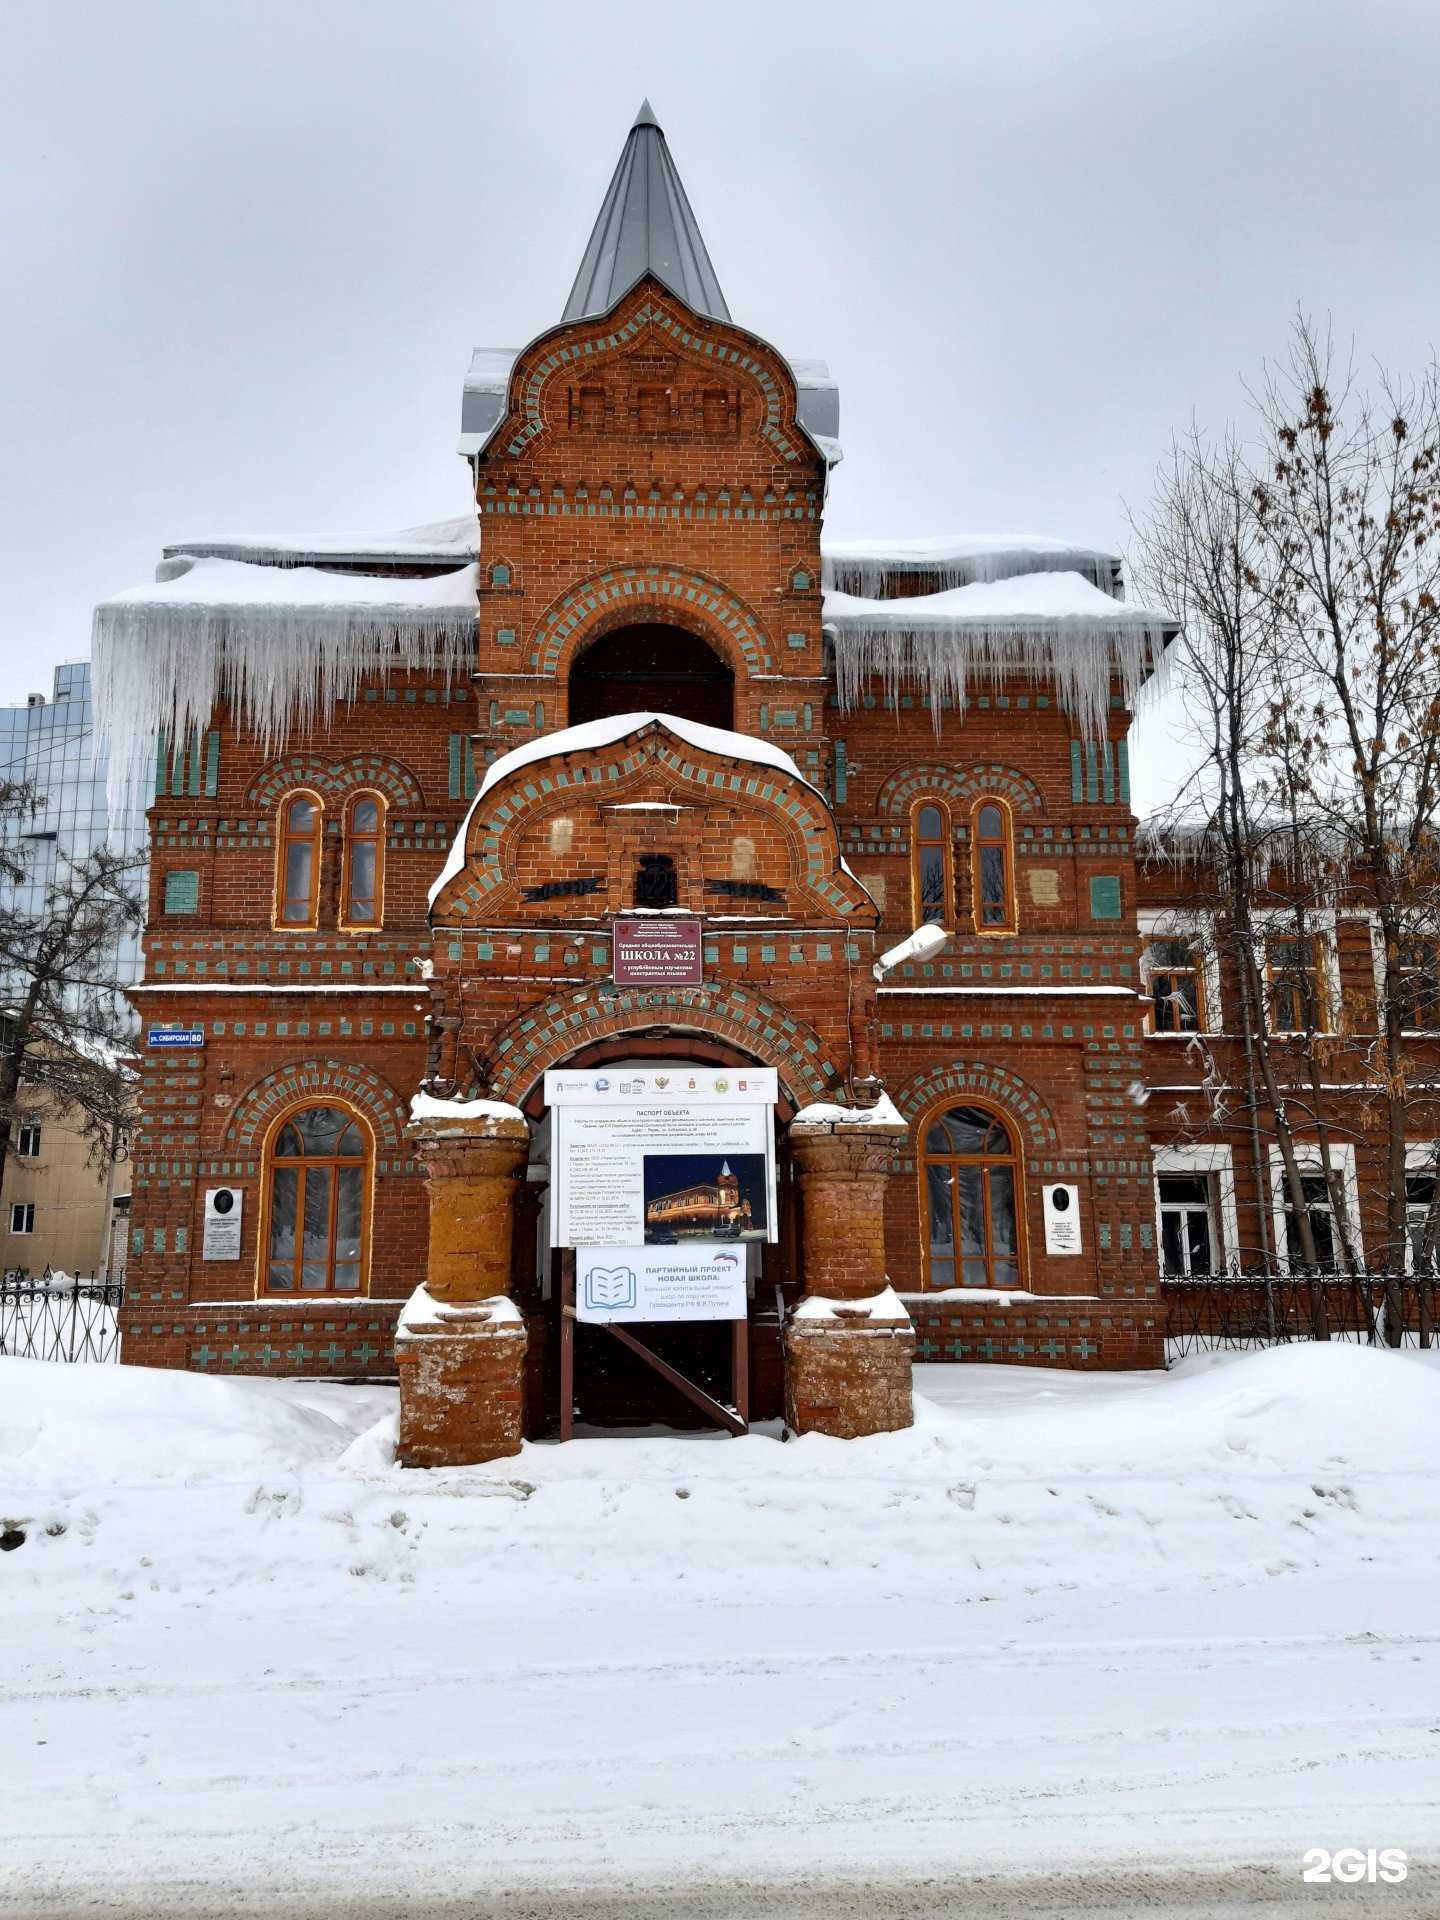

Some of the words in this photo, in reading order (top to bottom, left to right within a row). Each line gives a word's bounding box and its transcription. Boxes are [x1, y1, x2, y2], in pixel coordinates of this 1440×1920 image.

[621, 951, 671, 961] ШКОЛА
[673, 951, 696, 961] №22
[645, 1266, 698, 1274] ПАРТИЙНЫЙ
[700, 1265, 732, 1273] ПРОЕКТ
